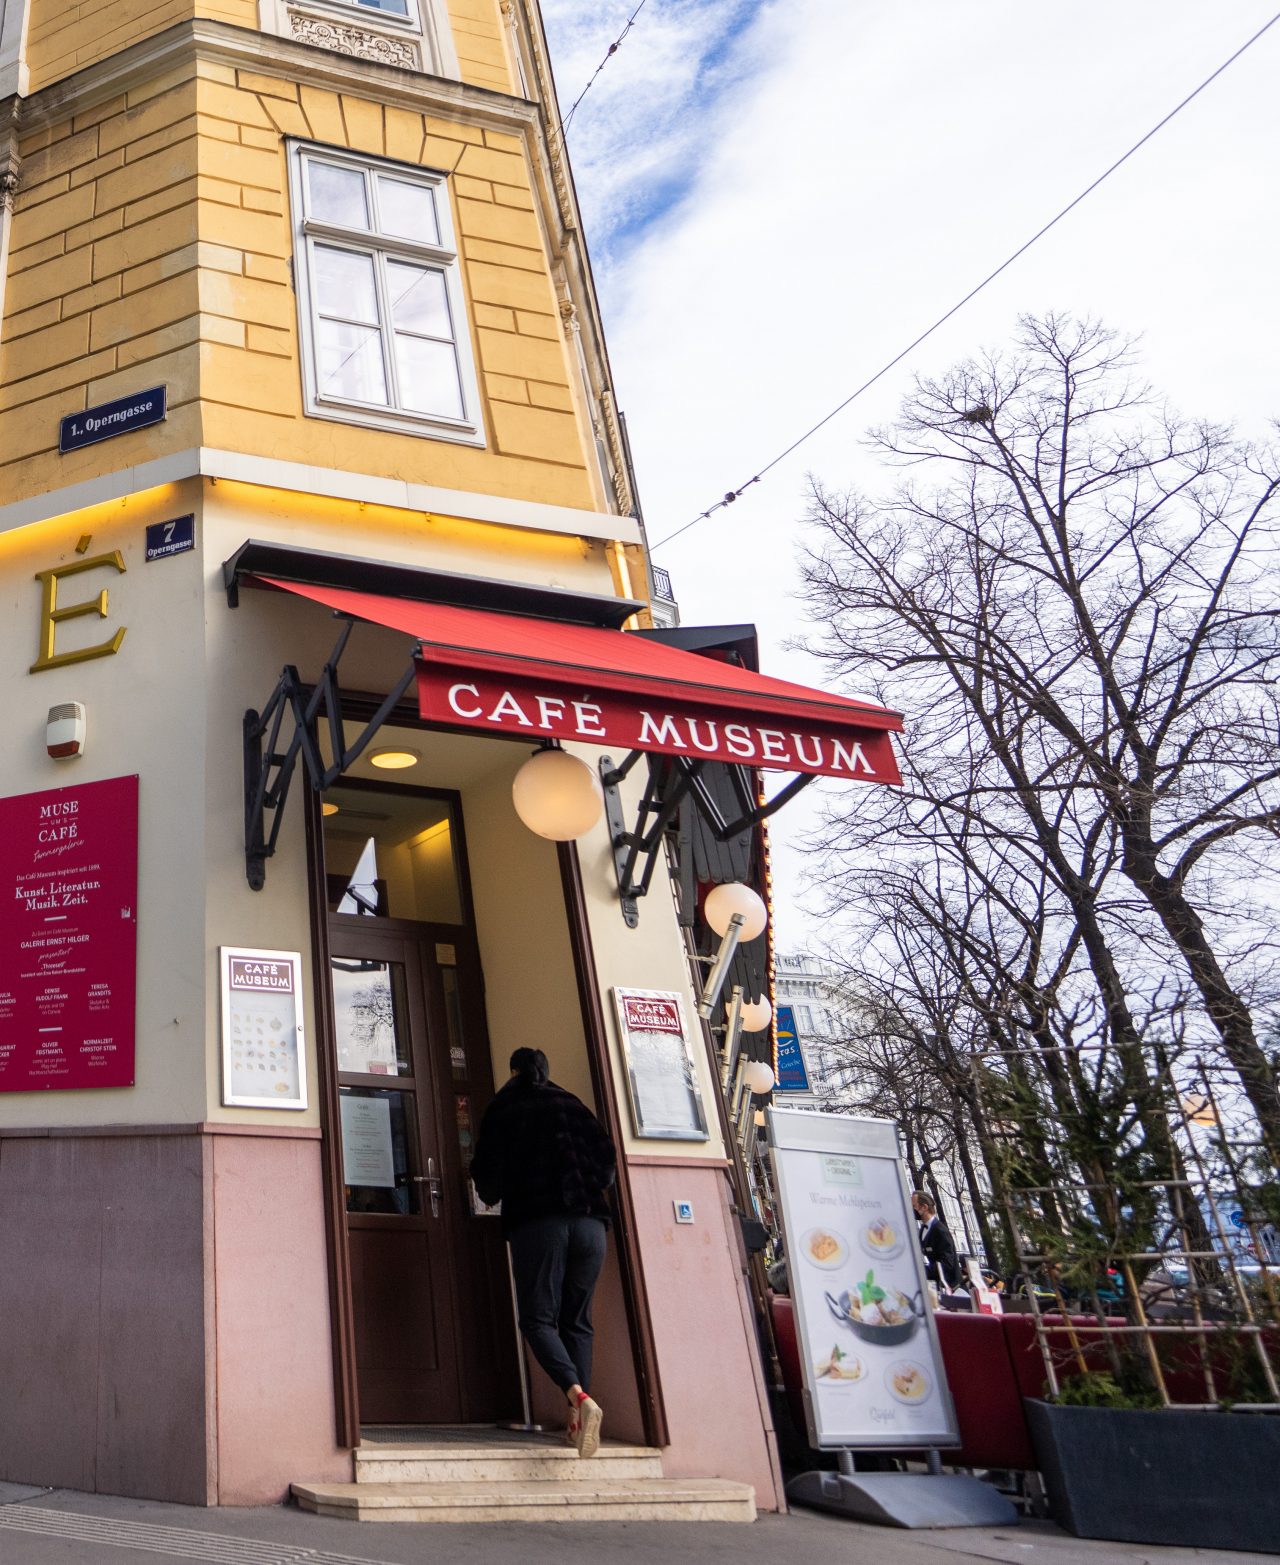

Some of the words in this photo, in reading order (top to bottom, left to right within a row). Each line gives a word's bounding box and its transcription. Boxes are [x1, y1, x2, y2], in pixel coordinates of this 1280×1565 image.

[86, 401, 152, 432] Operngasse
[163, 522, 176, 542] 7
[148, 538, 192, 557] Operngasse
[447, 683, 606, 737] CAFÉ
[637, 711, 876, 775] MUSEUM
[40, 800, 79, 818] MUSE
[38, 822, 78, 842] CAFÉ
[15, 884, 47, 900] Kunst.
[50, 880, 100, 895] Literatur.
[25, 897, 60, 911] Musik.
[62, 894, 88, 906] Zeit.
[20, 939, 46, 949] GALERIE
[46, 936, 66, 946] ERNST
[68, 934, 90, 944] HILGER
[244, 962, 278, 976] CAFÉ
[234, 975, 290, 987] MUSEUM
[636, 1004, 666, 1015] CAFÉ
[630, 1014, 677, 1026] MUSEUM
